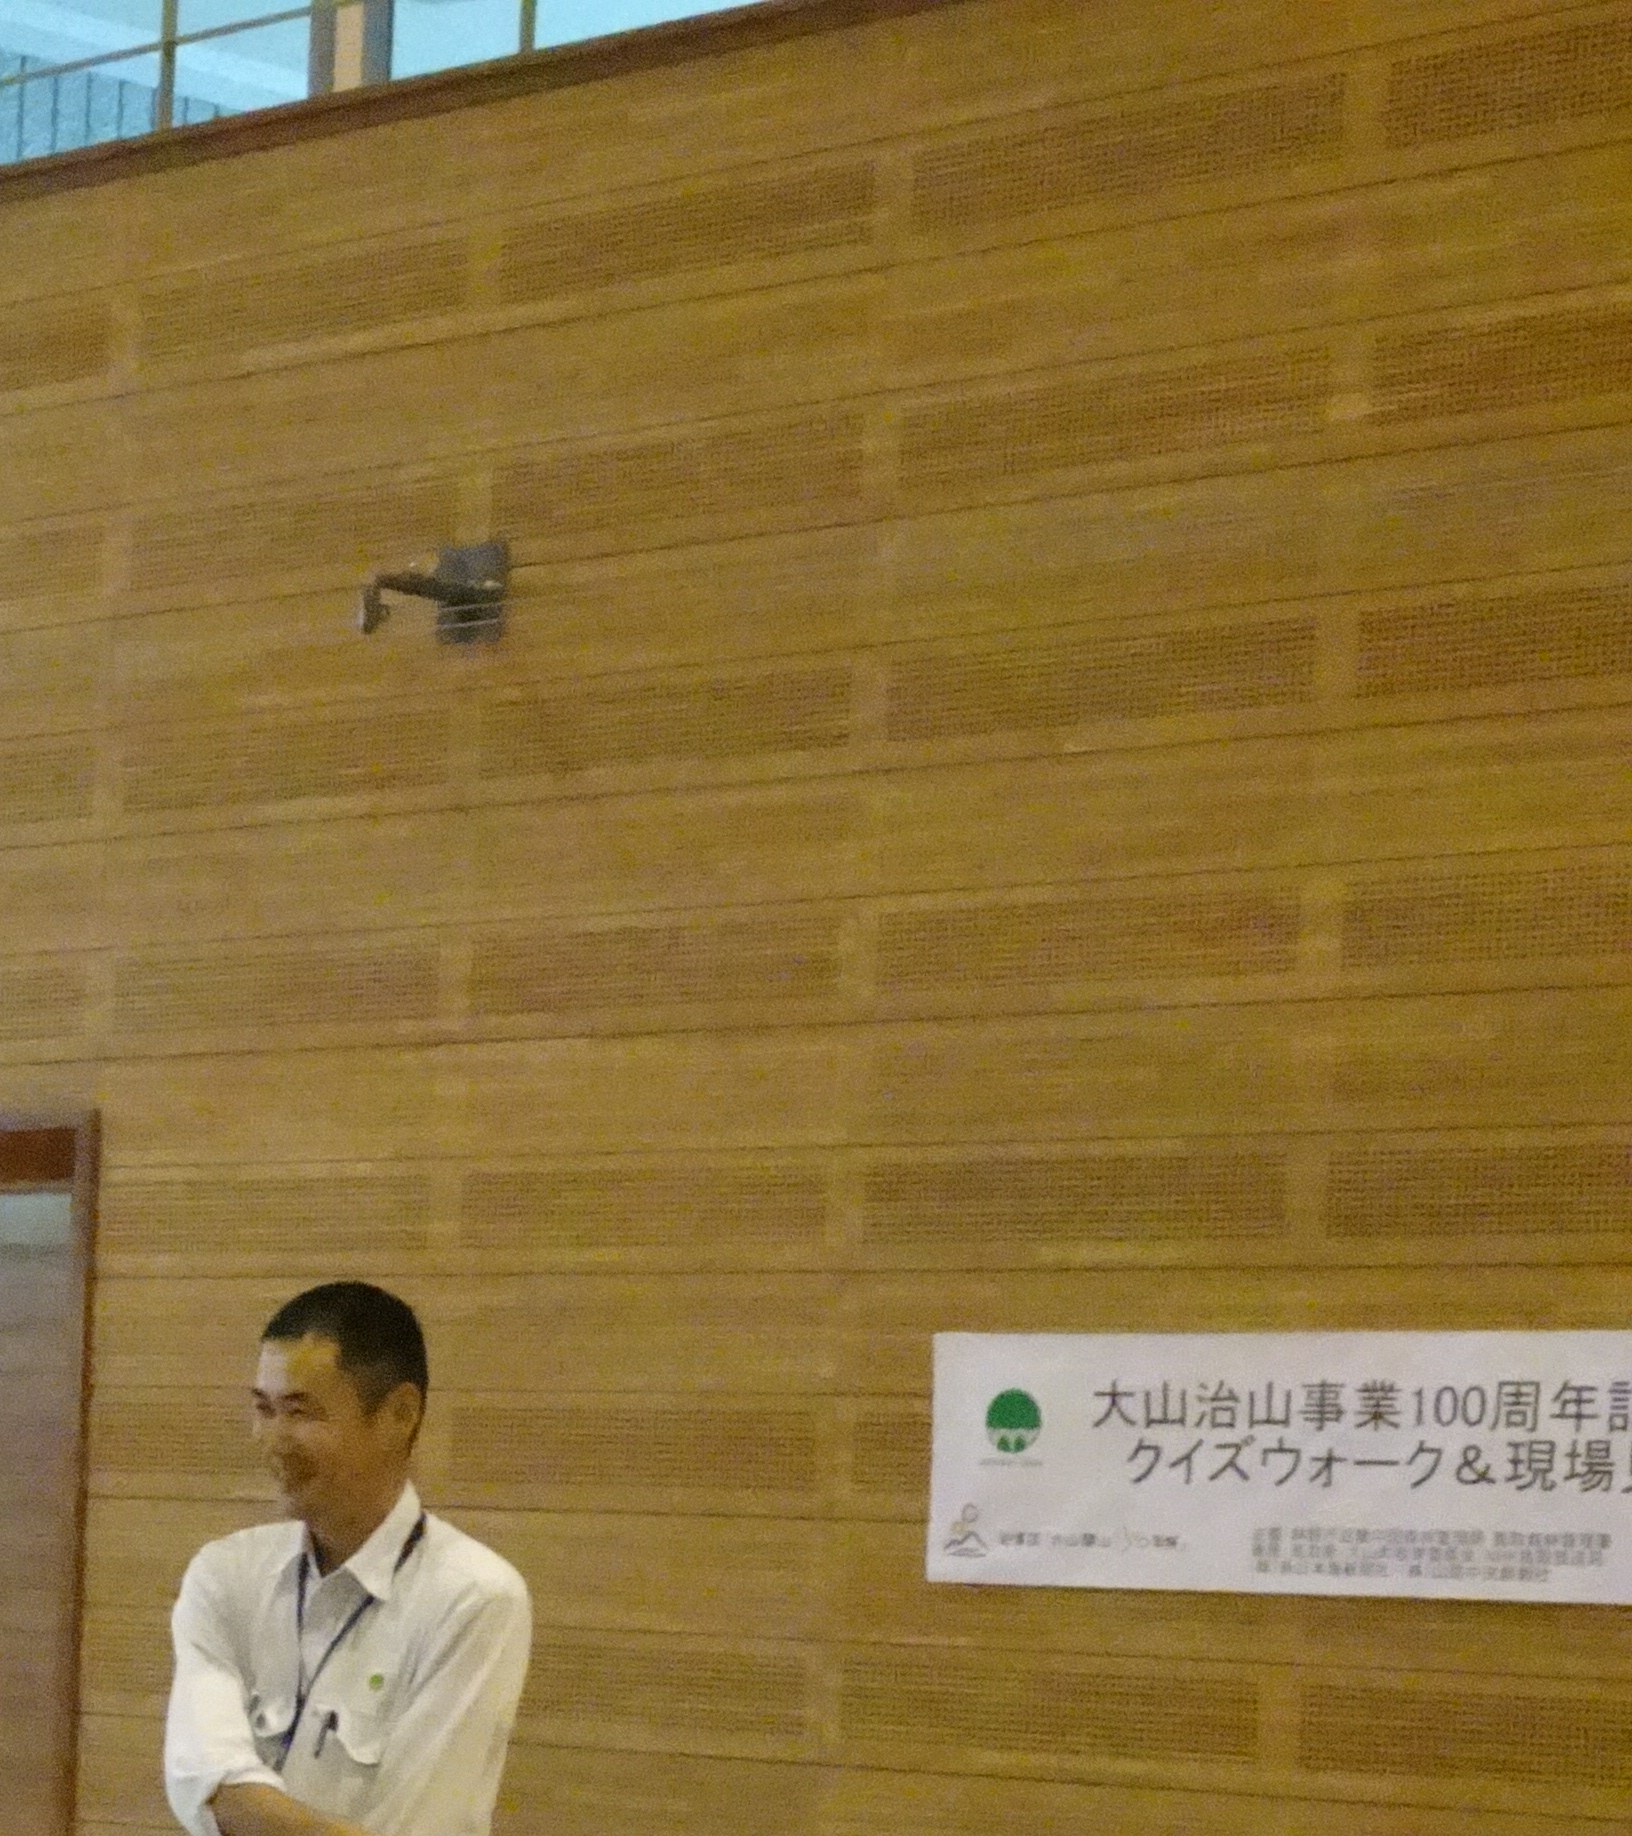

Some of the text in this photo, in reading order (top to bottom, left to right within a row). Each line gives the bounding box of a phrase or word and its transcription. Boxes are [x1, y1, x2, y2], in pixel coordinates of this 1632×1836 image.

[1127, 1436, 1632, 1493] クイズウォーク&現場
